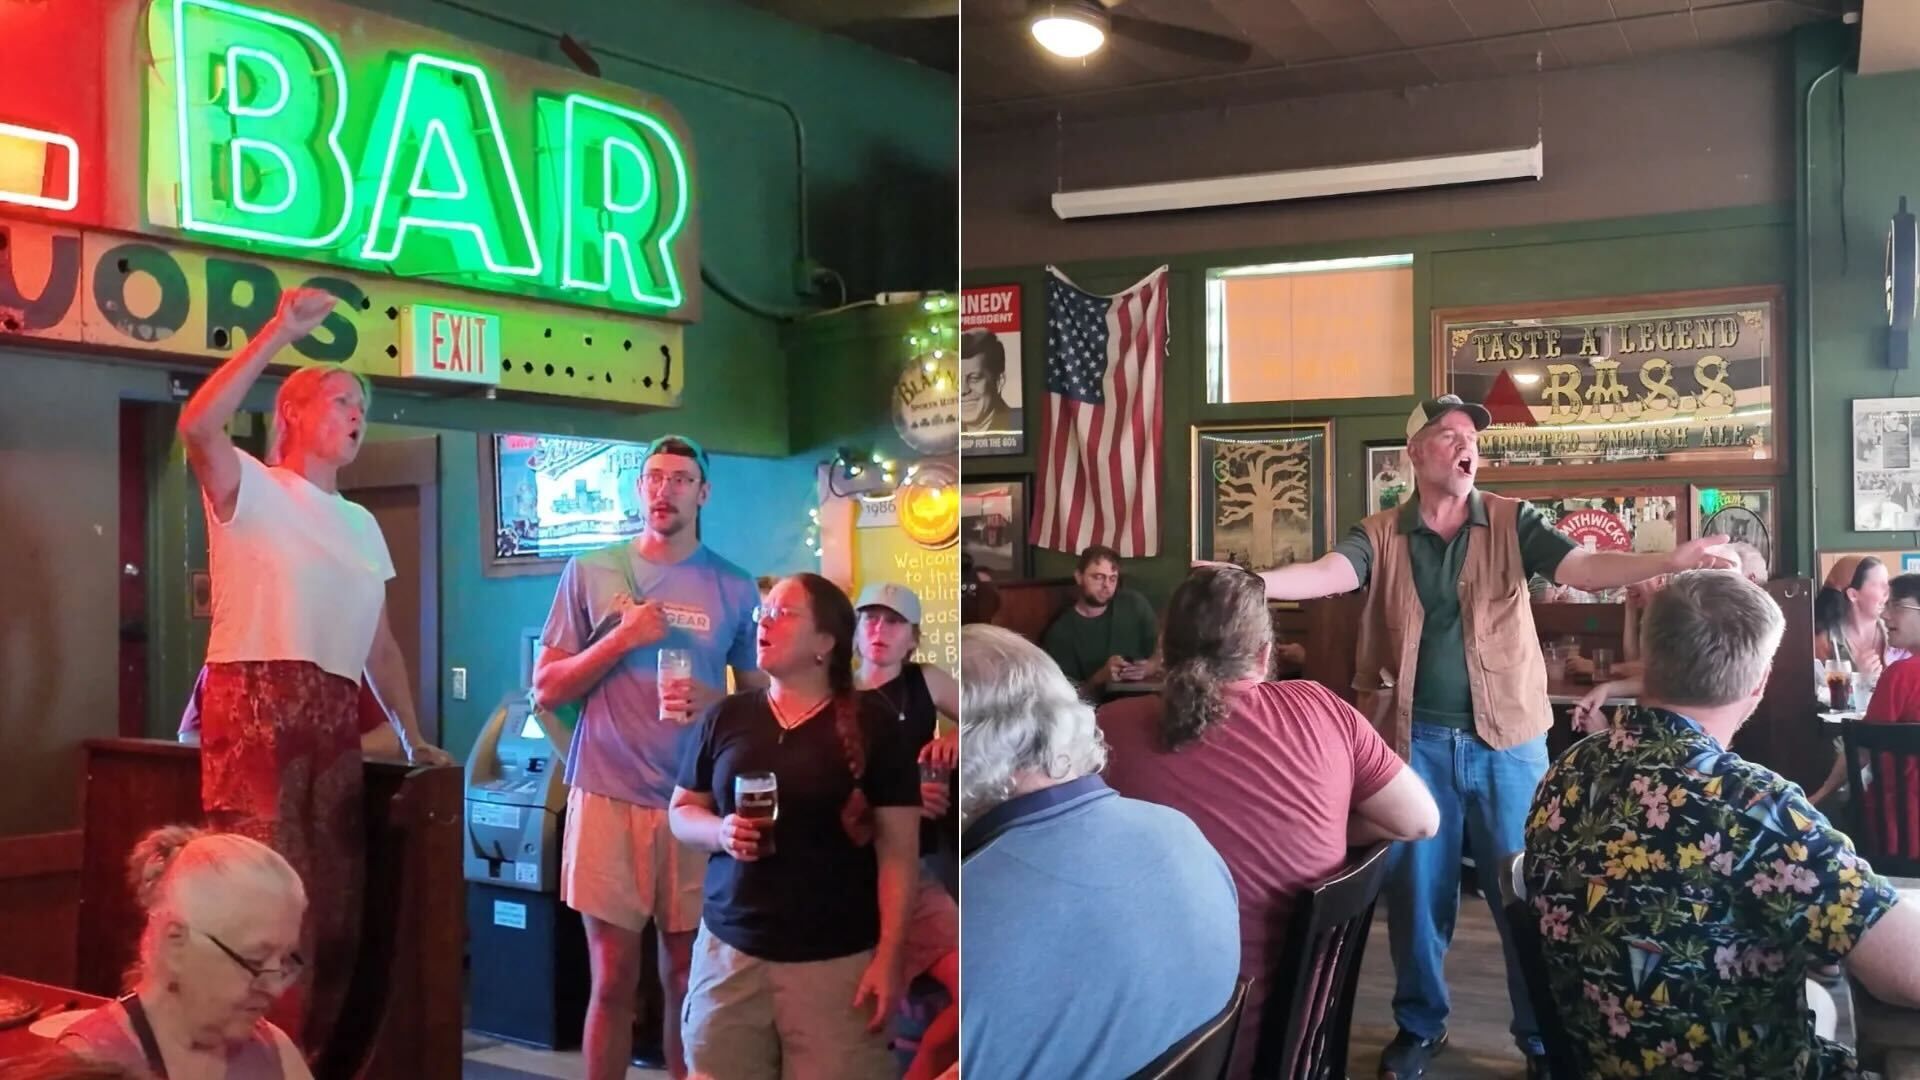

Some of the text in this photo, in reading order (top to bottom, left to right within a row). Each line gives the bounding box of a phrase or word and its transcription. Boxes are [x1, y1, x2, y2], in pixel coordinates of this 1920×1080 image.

[150, 0, 688, 308] BAR
[432, 311, 487, 374] EXIT
[1472, 317, 1740, 362] TASTE A LEGEND
[1541, 355, 1737, 424] BASS
[1478, 424, 1745, 455] MPORTED ENGLISH ALE
[905, 570, 922, 584] to
[667, 612, 706, 627] GEAR
